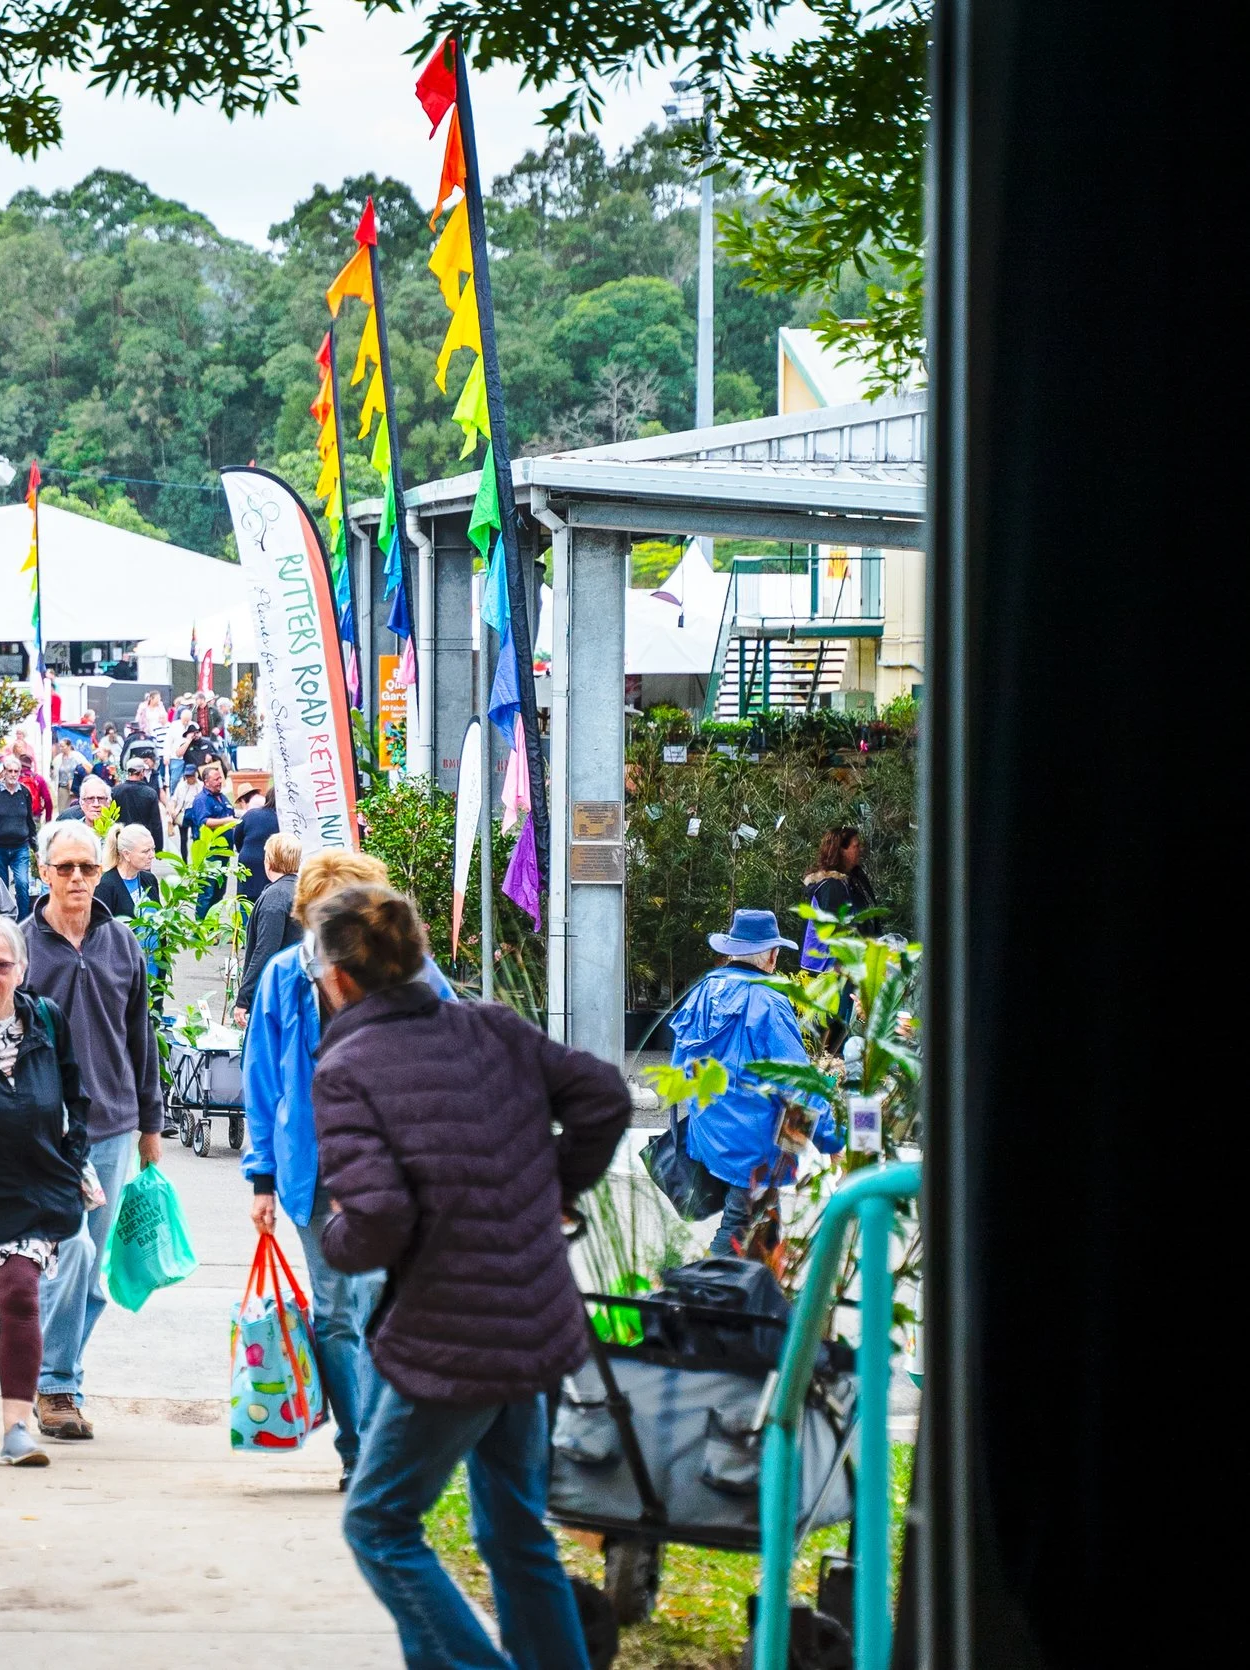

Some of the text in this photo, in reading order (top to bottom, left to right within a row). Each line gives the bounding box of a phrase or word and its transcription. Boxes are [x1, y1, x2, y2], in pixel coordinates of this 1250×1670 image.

[275, 553, 320, 654] RUTTERS
[291, 663, 327, 726] ROAD
[261, 651, 278, 677] for
[271, 698, 299, 805] Sustainable
[308, 734, 338, 812] RETAIL
[116, 1205, 162, 1239] FRIENDLY
[119, 1200, 152, 1225] EARTH
[136, 1229, 158, 1249] BAG
